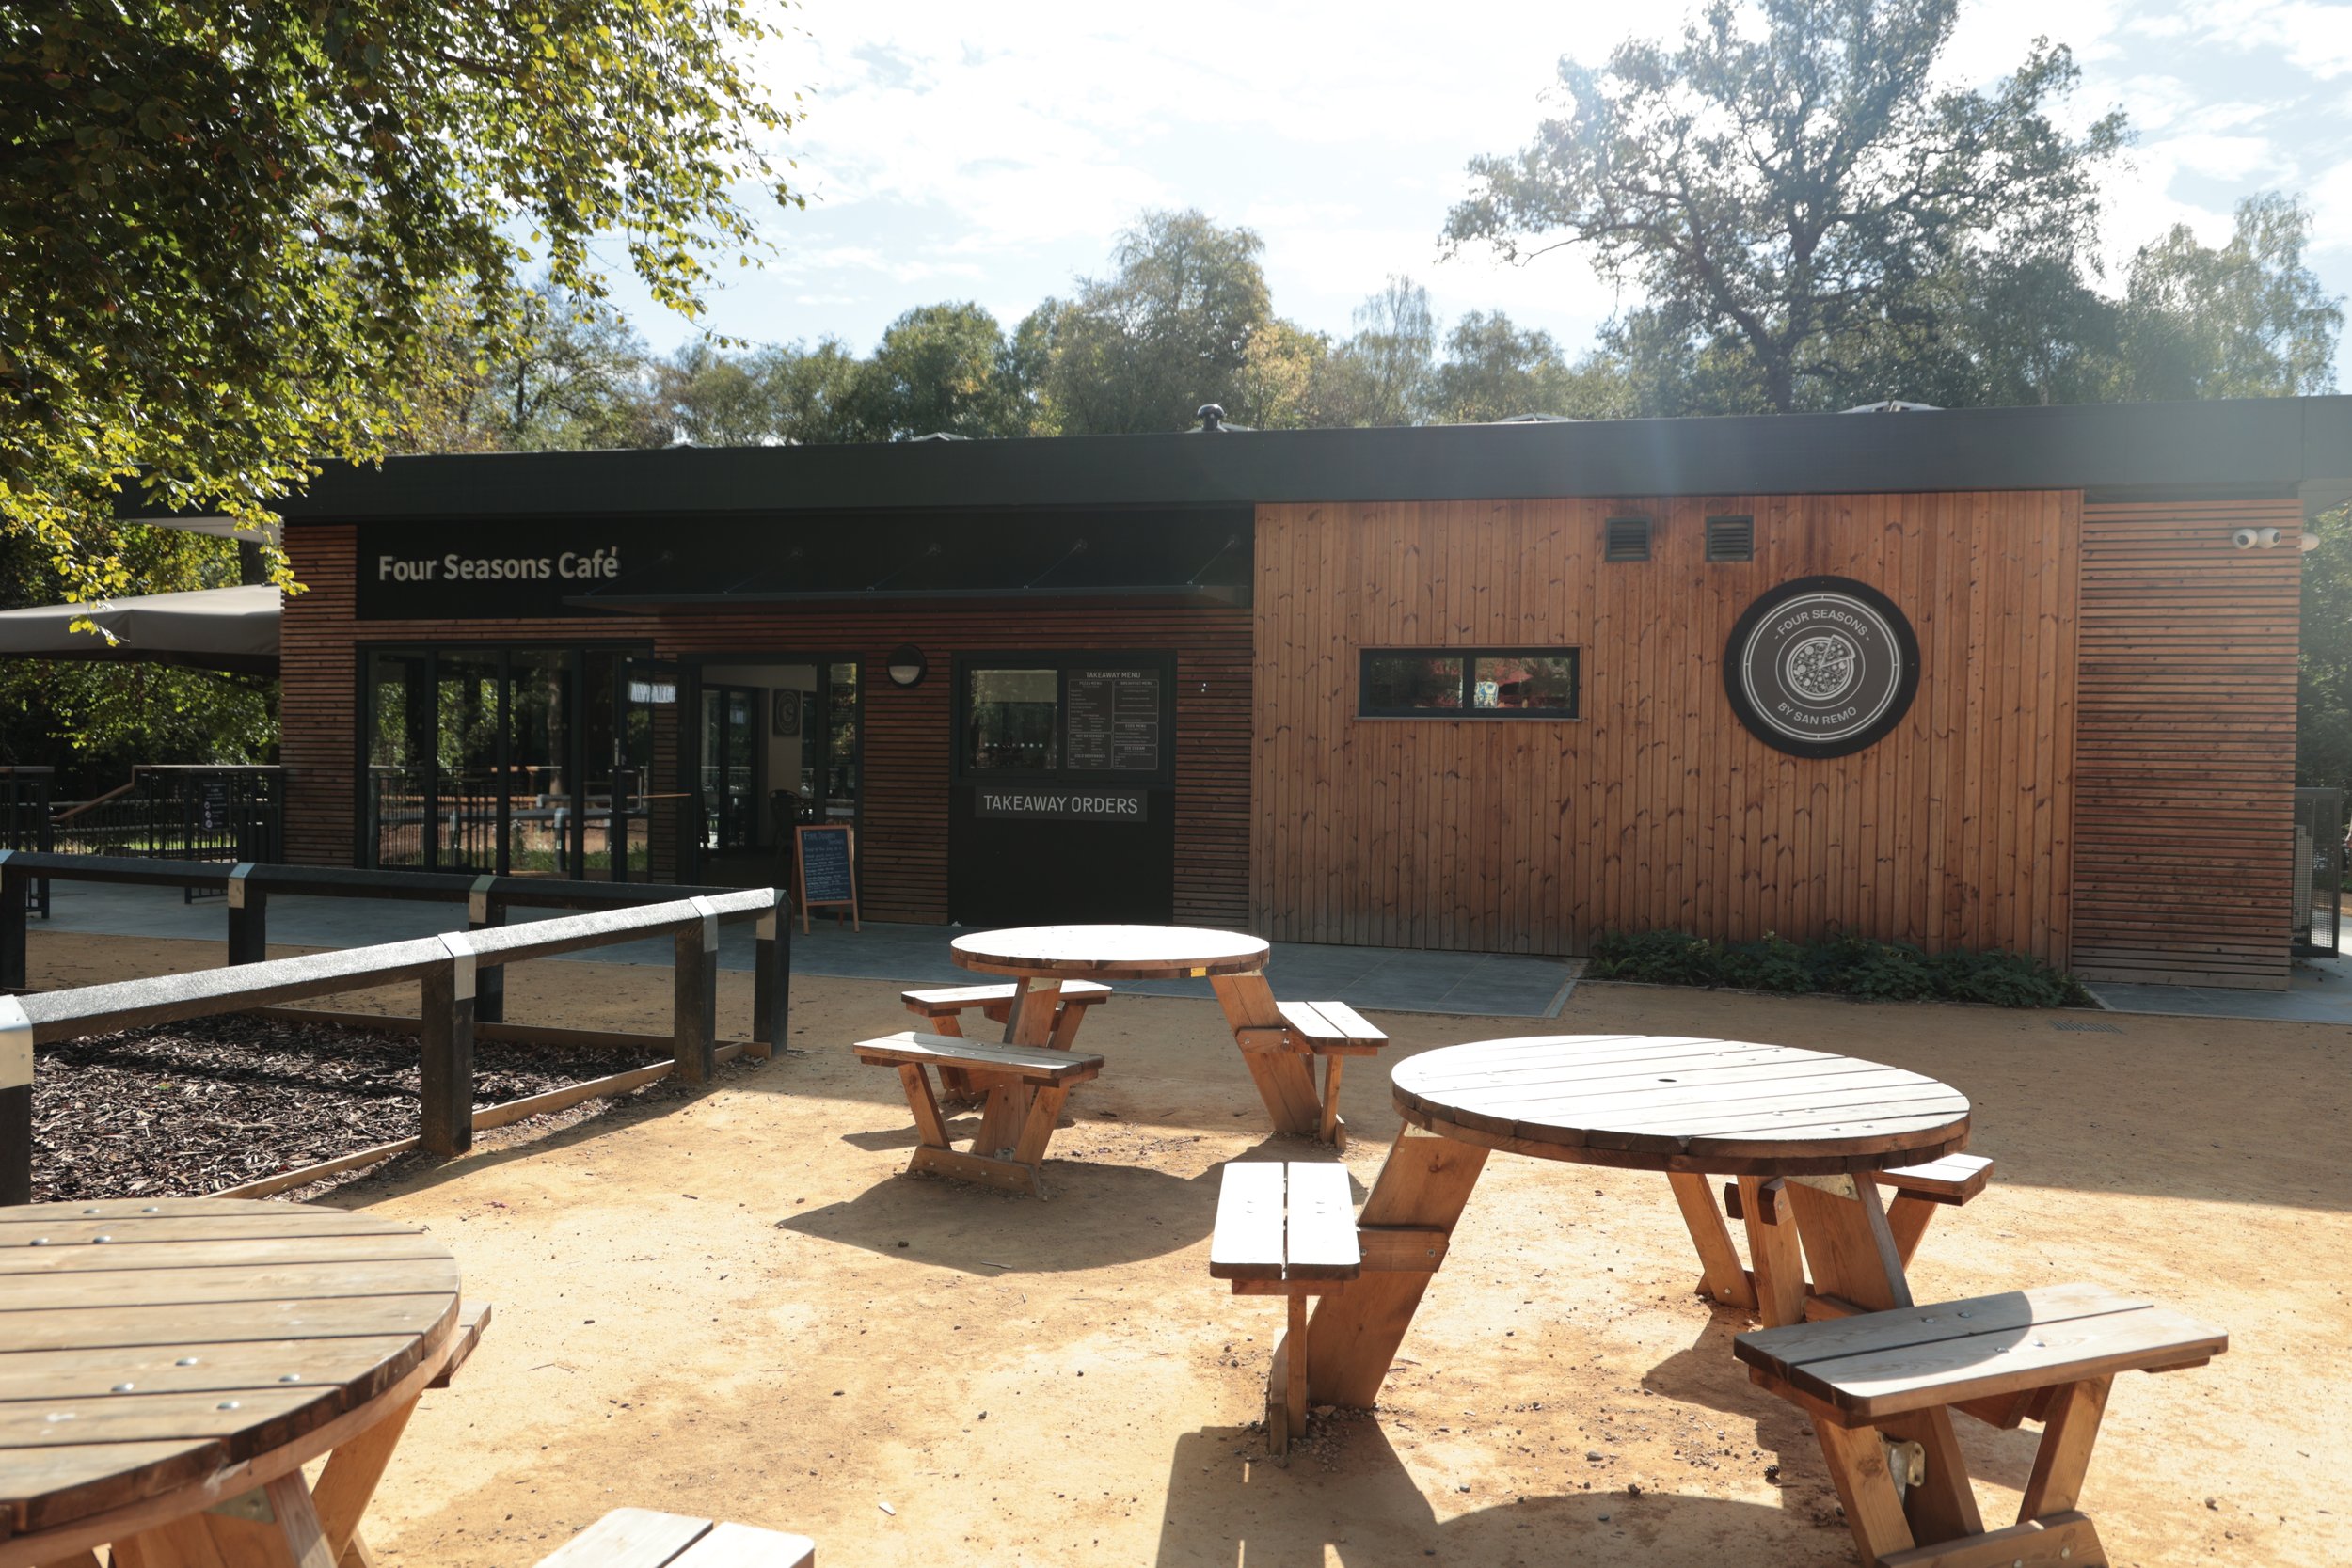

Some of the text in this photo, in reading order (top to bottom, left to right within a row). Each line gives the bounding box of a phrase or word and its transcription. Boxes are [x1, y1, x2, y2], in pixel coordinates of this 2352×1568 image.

[378, 546, 619, 582] Four Seasons Café
[1776, 609, 1868, 636] FOUR SEASONS
[1776, 701, 1857, 725] BY SAN REMO
[983, 794, 1138, 815] TAKEAWAY ORDERS
